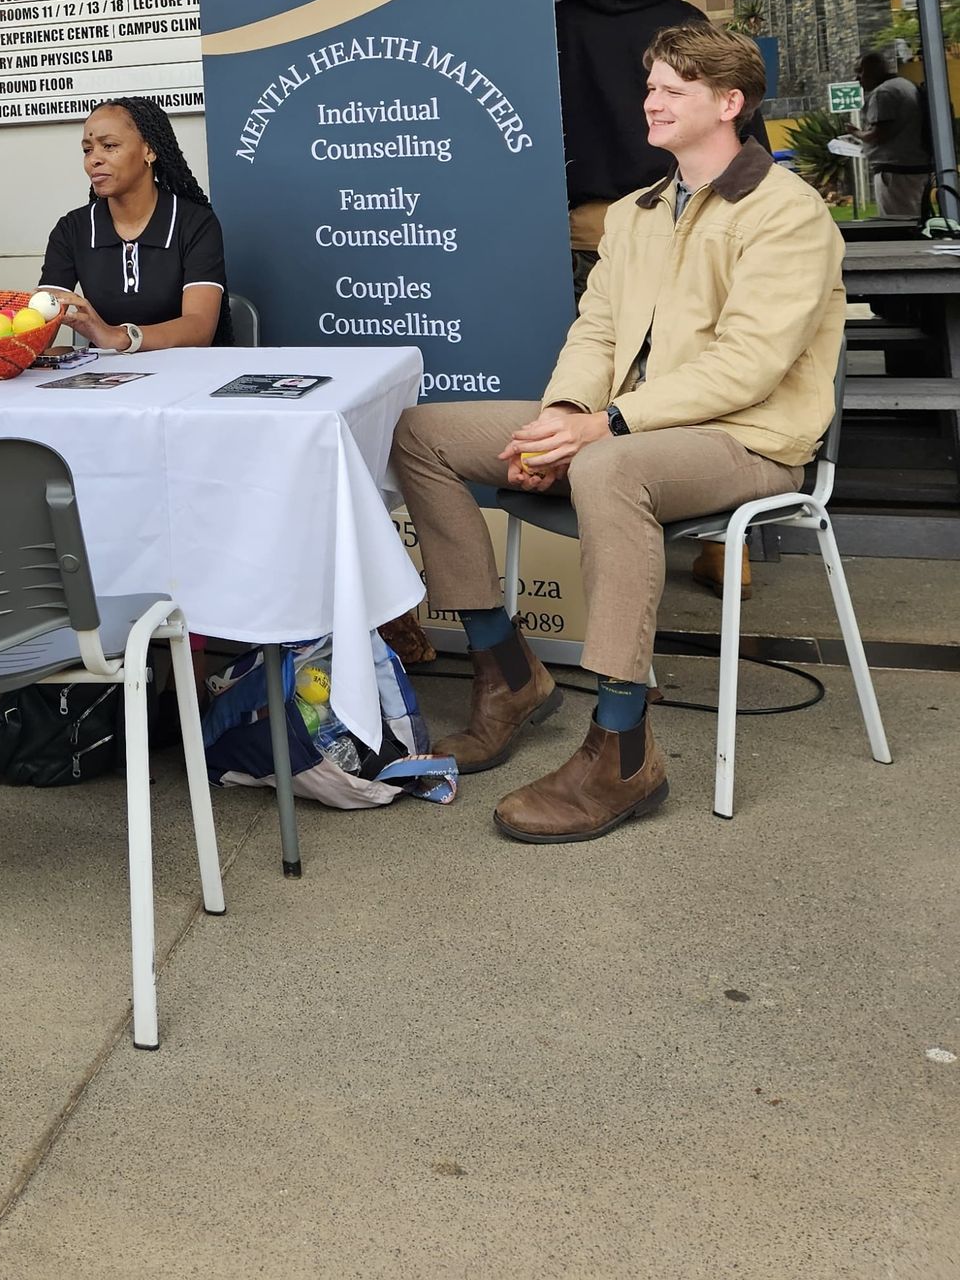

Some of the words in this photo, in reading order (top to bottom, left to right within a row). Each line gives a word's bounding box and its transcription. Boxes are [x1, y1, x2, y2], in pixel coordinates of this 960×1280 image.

[0, 6, 39, 22] ROOMS
[42, 5, 51, 18] 11
[63, 3, 75, 16] 12
[87, 1, 100, 15] 13
[111, 0, 123, 12] 18
[1, 29, 64, 46] EXPERIENCE
[67, 24, 109, 40] CENTRE
[119, 20, 167, 36] CAMPUS
[16, 54, 37, 68] AND
[41, 50, 88, 67] PHYSICS
[92, 49, 112, 62] LAB
[40, 77, 73, 91] FLOOR
[25, 100, 97, 116] ENGINEERING
[236, 64, 310, 164] MENTAL
[308, 37, 421, 75] HEALTH
[423, 46, 532, 153] MATTERS
[318, 98, 440, 125] Individual
[311, 136, 452, 162] Counselling
[339, 188, 420, 216] Family
[315, 224, 457, 251] Counselling
[336, 276, 431, 305] Couples
[319, 313, 461, 342] Counselling
[420, 372, 500, 397] porate
[517, 610, 565, 633] 089
